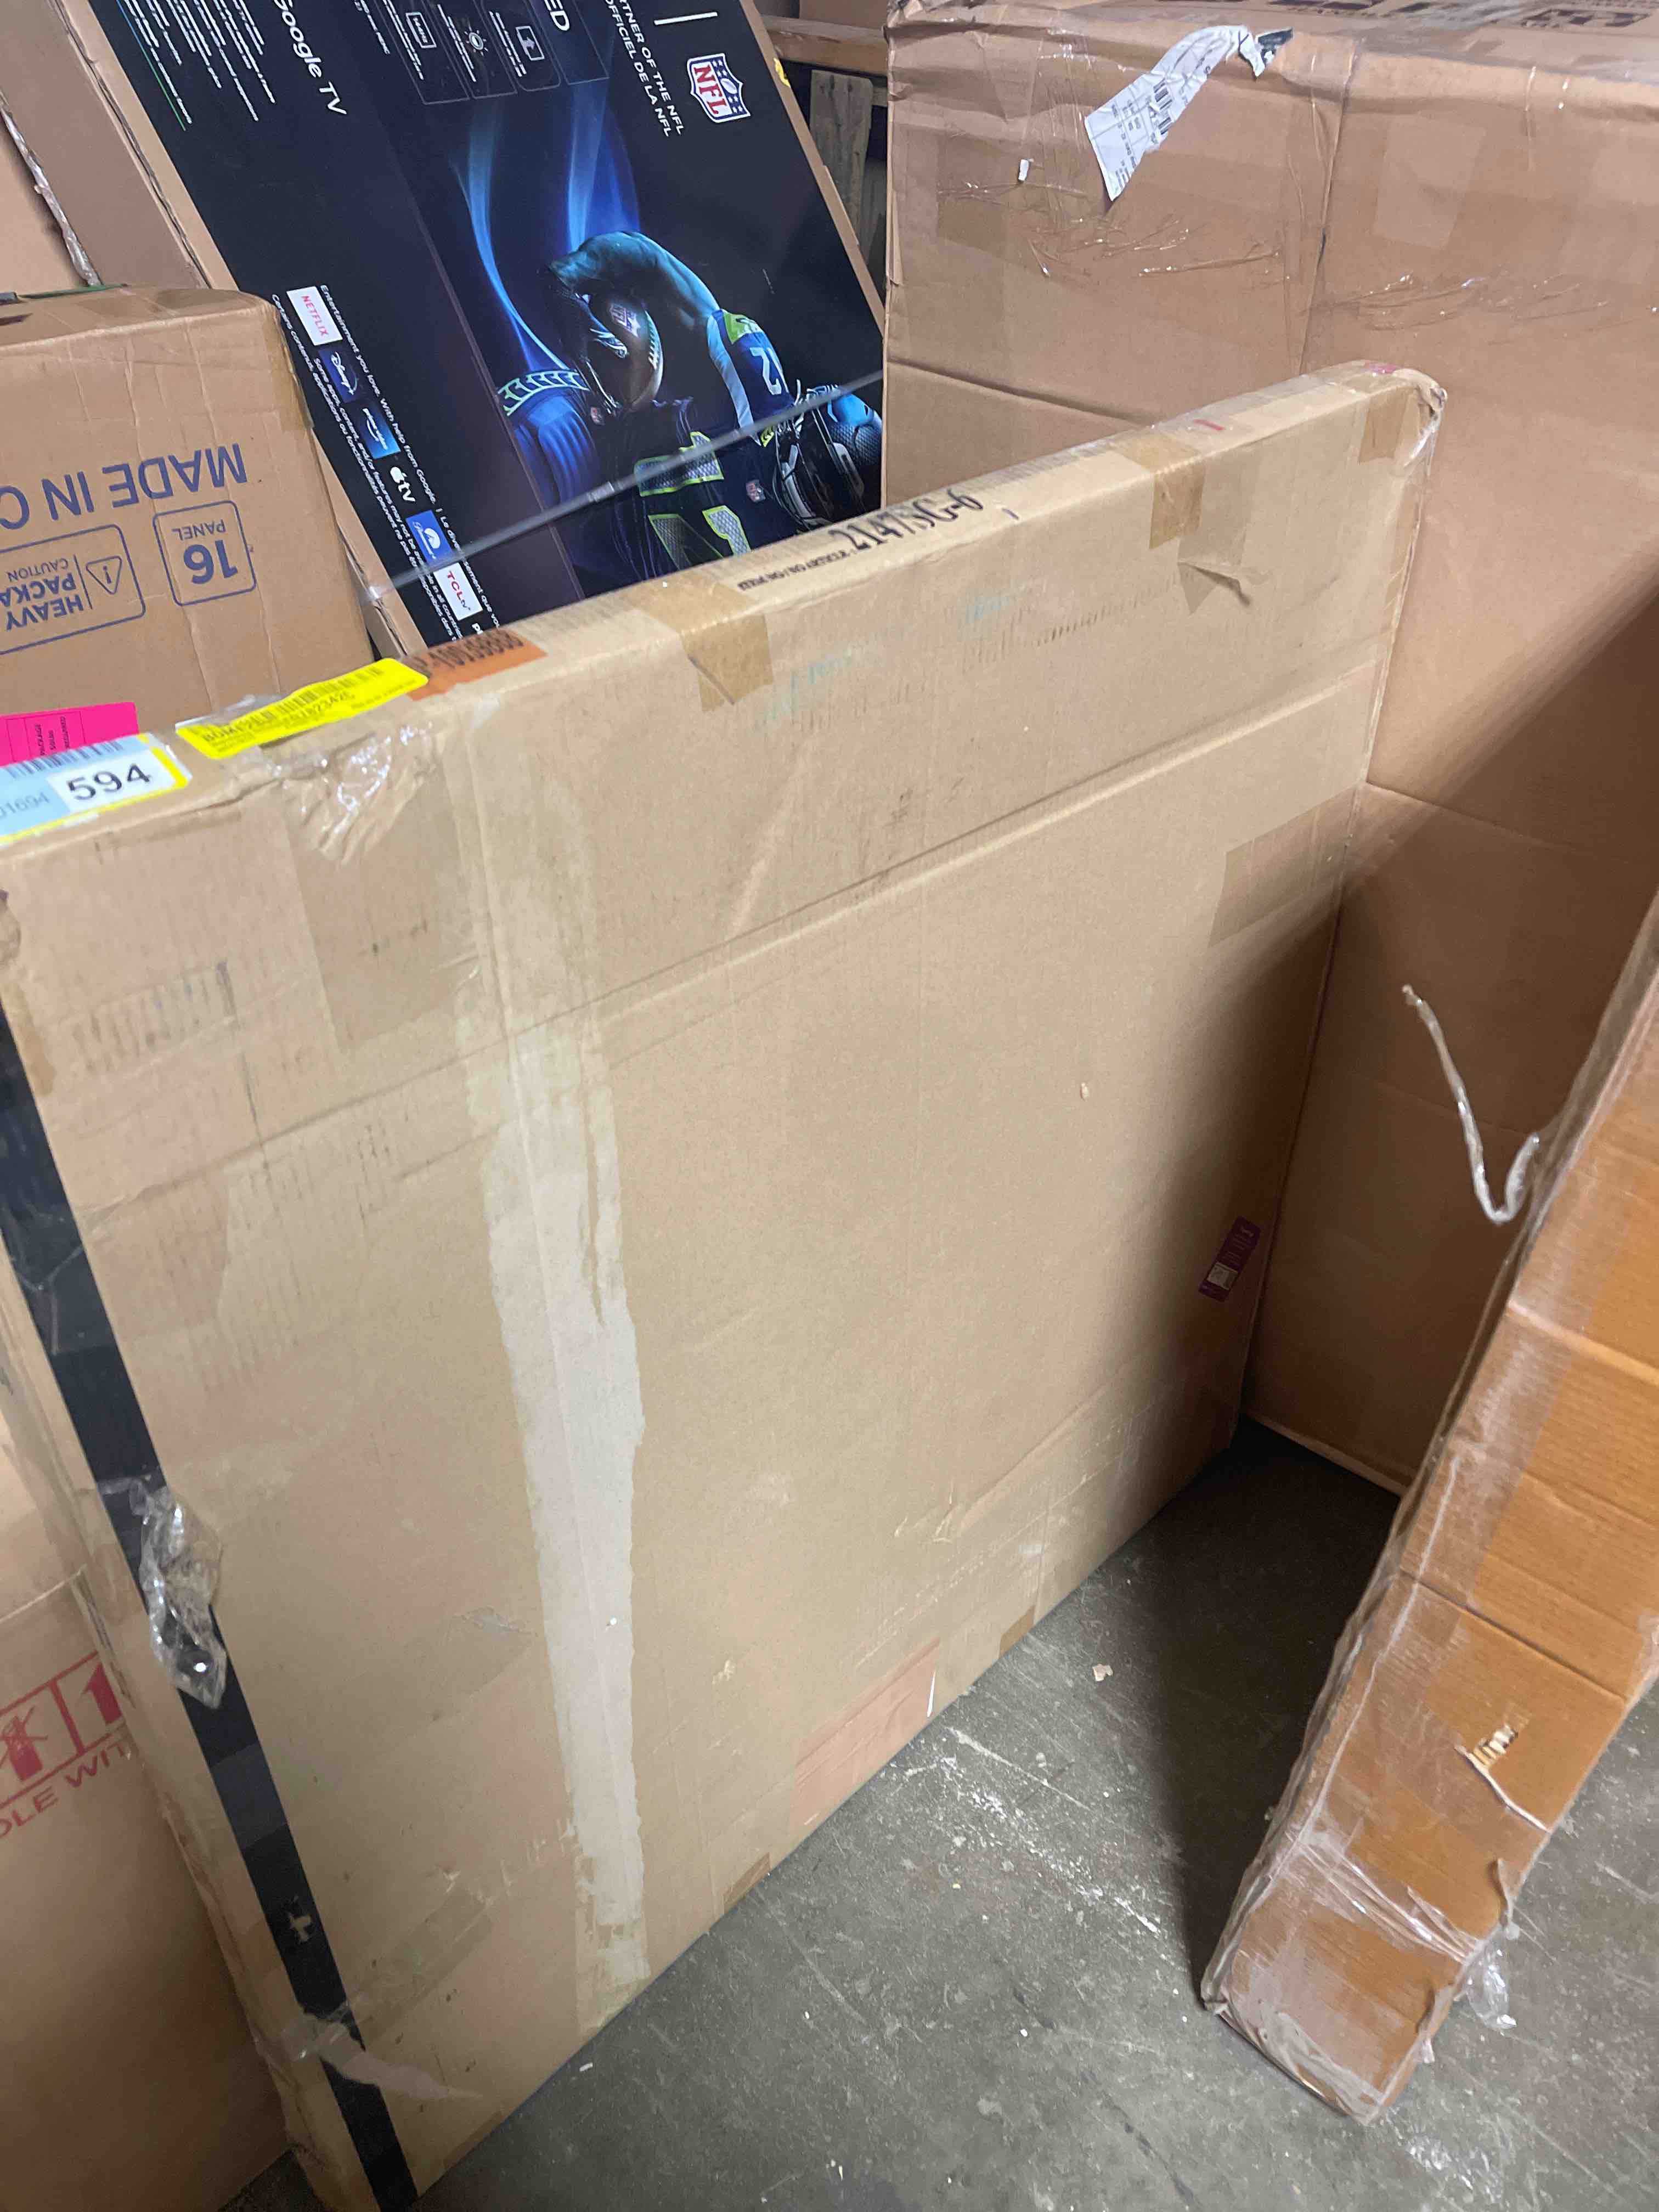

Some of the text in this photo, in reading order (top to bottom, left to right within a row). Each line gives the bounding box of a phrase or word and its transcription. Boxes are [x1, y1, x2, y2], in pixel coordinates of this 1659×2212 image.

[273, 0, 347, 115] Google TV
[634, 61, 650, 83] DE
[644, 86, 658, 105] LA
[655, 107, 672, 137] NFL
[641, 47, 657, 69] OF
[653, 72, 672, 102] THE
[667, 104, 685, 136] NFL
[693, 65, 727, 115] NFL
[302, 295, 329, 336] NETFLIX
[313, 358, 330, 383] Some
[357, 443, 376, 470] and/or
[391, 505, 403, 523] may
[400, 523, 411, 538] not
[408, 539, 417, 550] be
[320, 285, 360, 352] Entertainment
[356, 355, 369, 373] you
[380, 398, 394, 422] With
[392, 423, 405, 444] help
[404, 445, 418, 467] from
[416, 469, 437, 504] Google.
[447, 529, 483, 594] divesement
[481, 595, 493, 612] que
[41, 471, 95, 521] IN
[102, 443, 248, 507] MADE
[398, 481, 416, 502] tv
[172, 519, 227, 541] PANEL
[7, 558, 70, 583] CAUTION
[183, 539, 239, 585] 16
[6, 594, 84, 631] HEAVY
[417, 573, 443, 616] isponibles
[66, 763, 153, 800] 594
